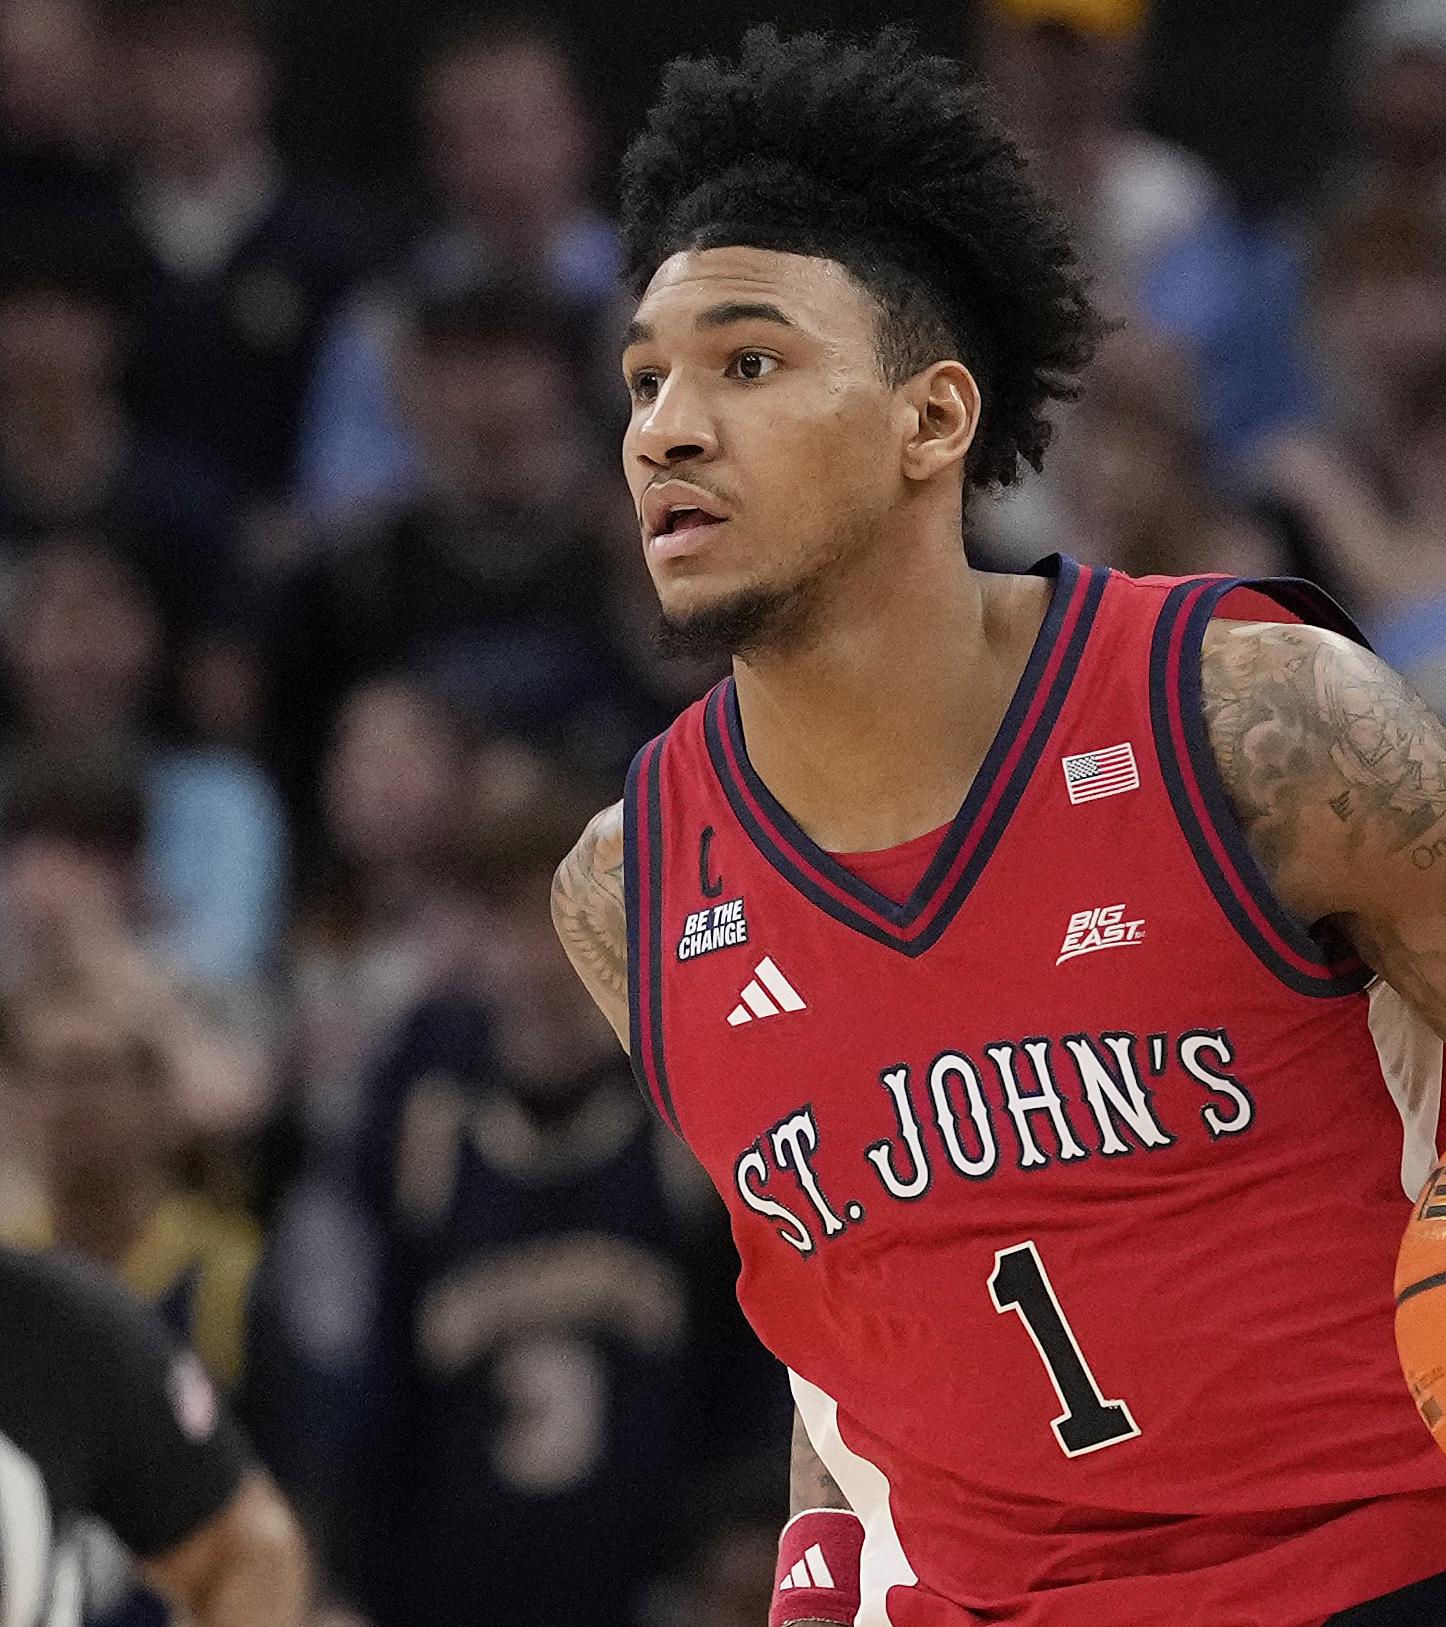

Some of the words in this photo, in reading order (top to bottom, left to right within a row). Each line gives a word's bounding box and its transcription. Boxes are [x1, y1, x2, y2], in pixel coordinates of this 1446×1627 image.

[700, 825, 723, 898] C
[684, 909, 710, 937] BE
[713, 899, 744, 928] THE
[1060, 919, 1146, 954] EAST
[1066, 903, 1127, 934] BIG
[678, 919, 748, 961] CHANGE
[733, 1105, 864, 1256] ST.
[866, 1029, 1253, 1200] JOHN'S
[986, 1240, 1142, 1459] 1
